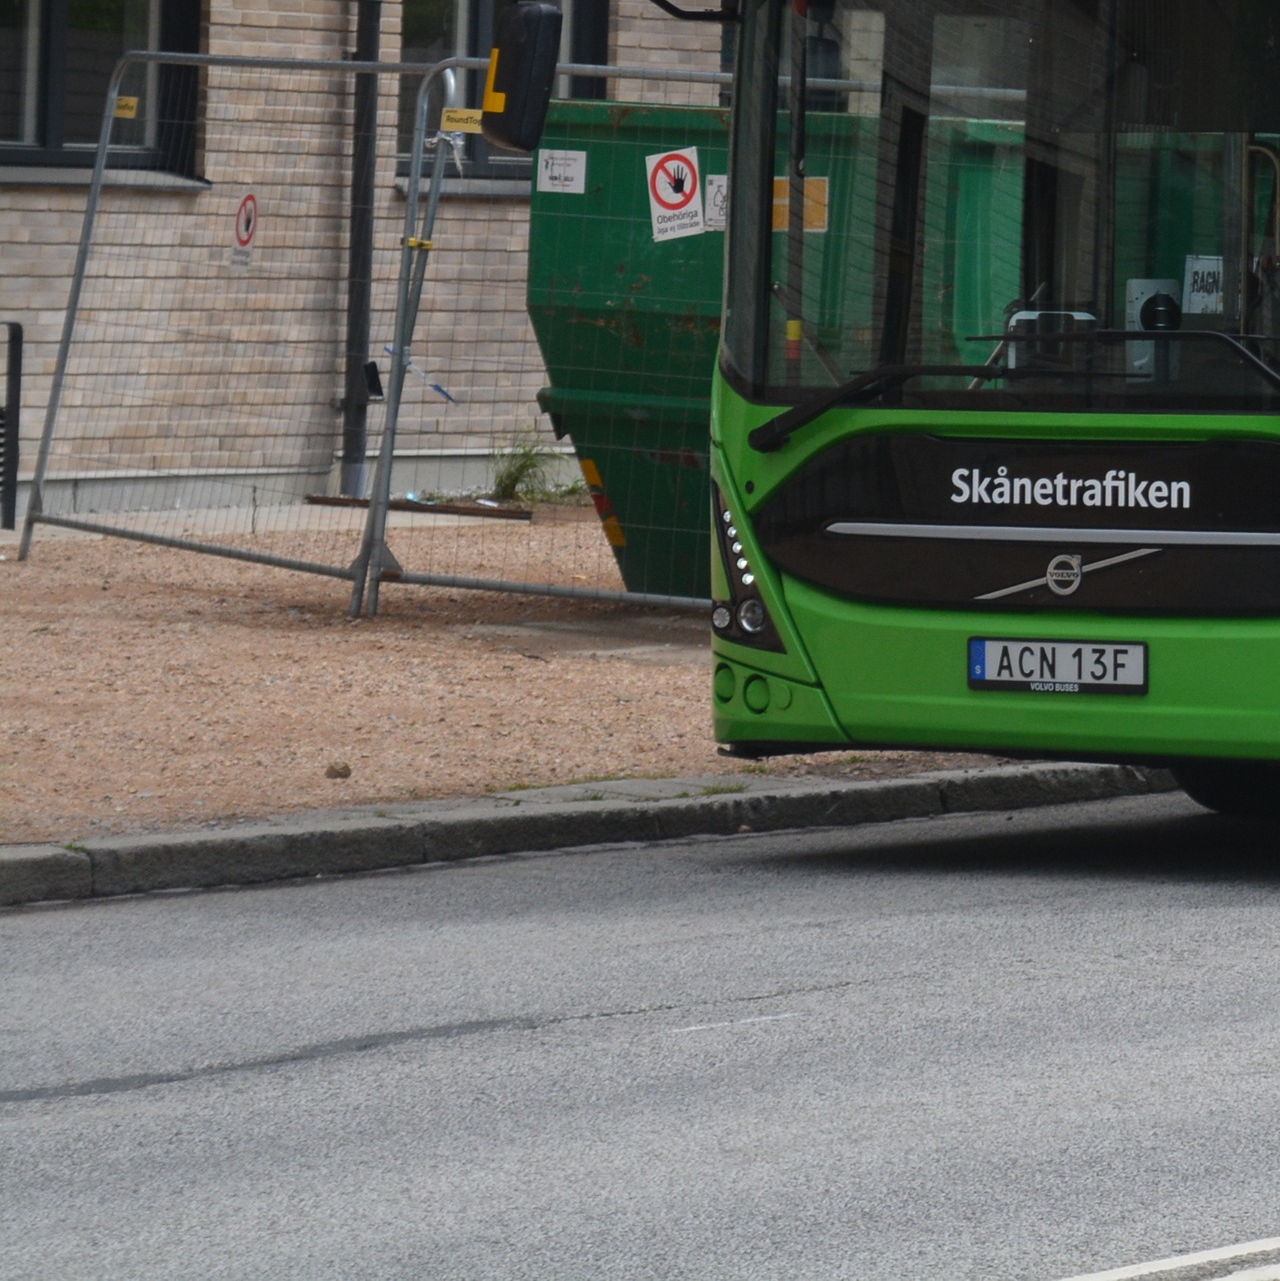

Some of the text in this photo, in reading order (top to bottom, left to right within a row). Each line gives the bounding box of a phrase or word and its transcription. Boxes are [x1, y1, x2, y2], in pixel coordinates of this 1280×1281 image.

[656, 210, 698, 224] Obehöriga
[950, 465, 1191, 509] Skånetrafiken
[1048, 571, 1080, 579] VOLVO
[974, 664, 982, 675] S
[996, 645, 1129, 682] ACN 13F
[1029, 681, 1080, 693] VOLVO BUSES
